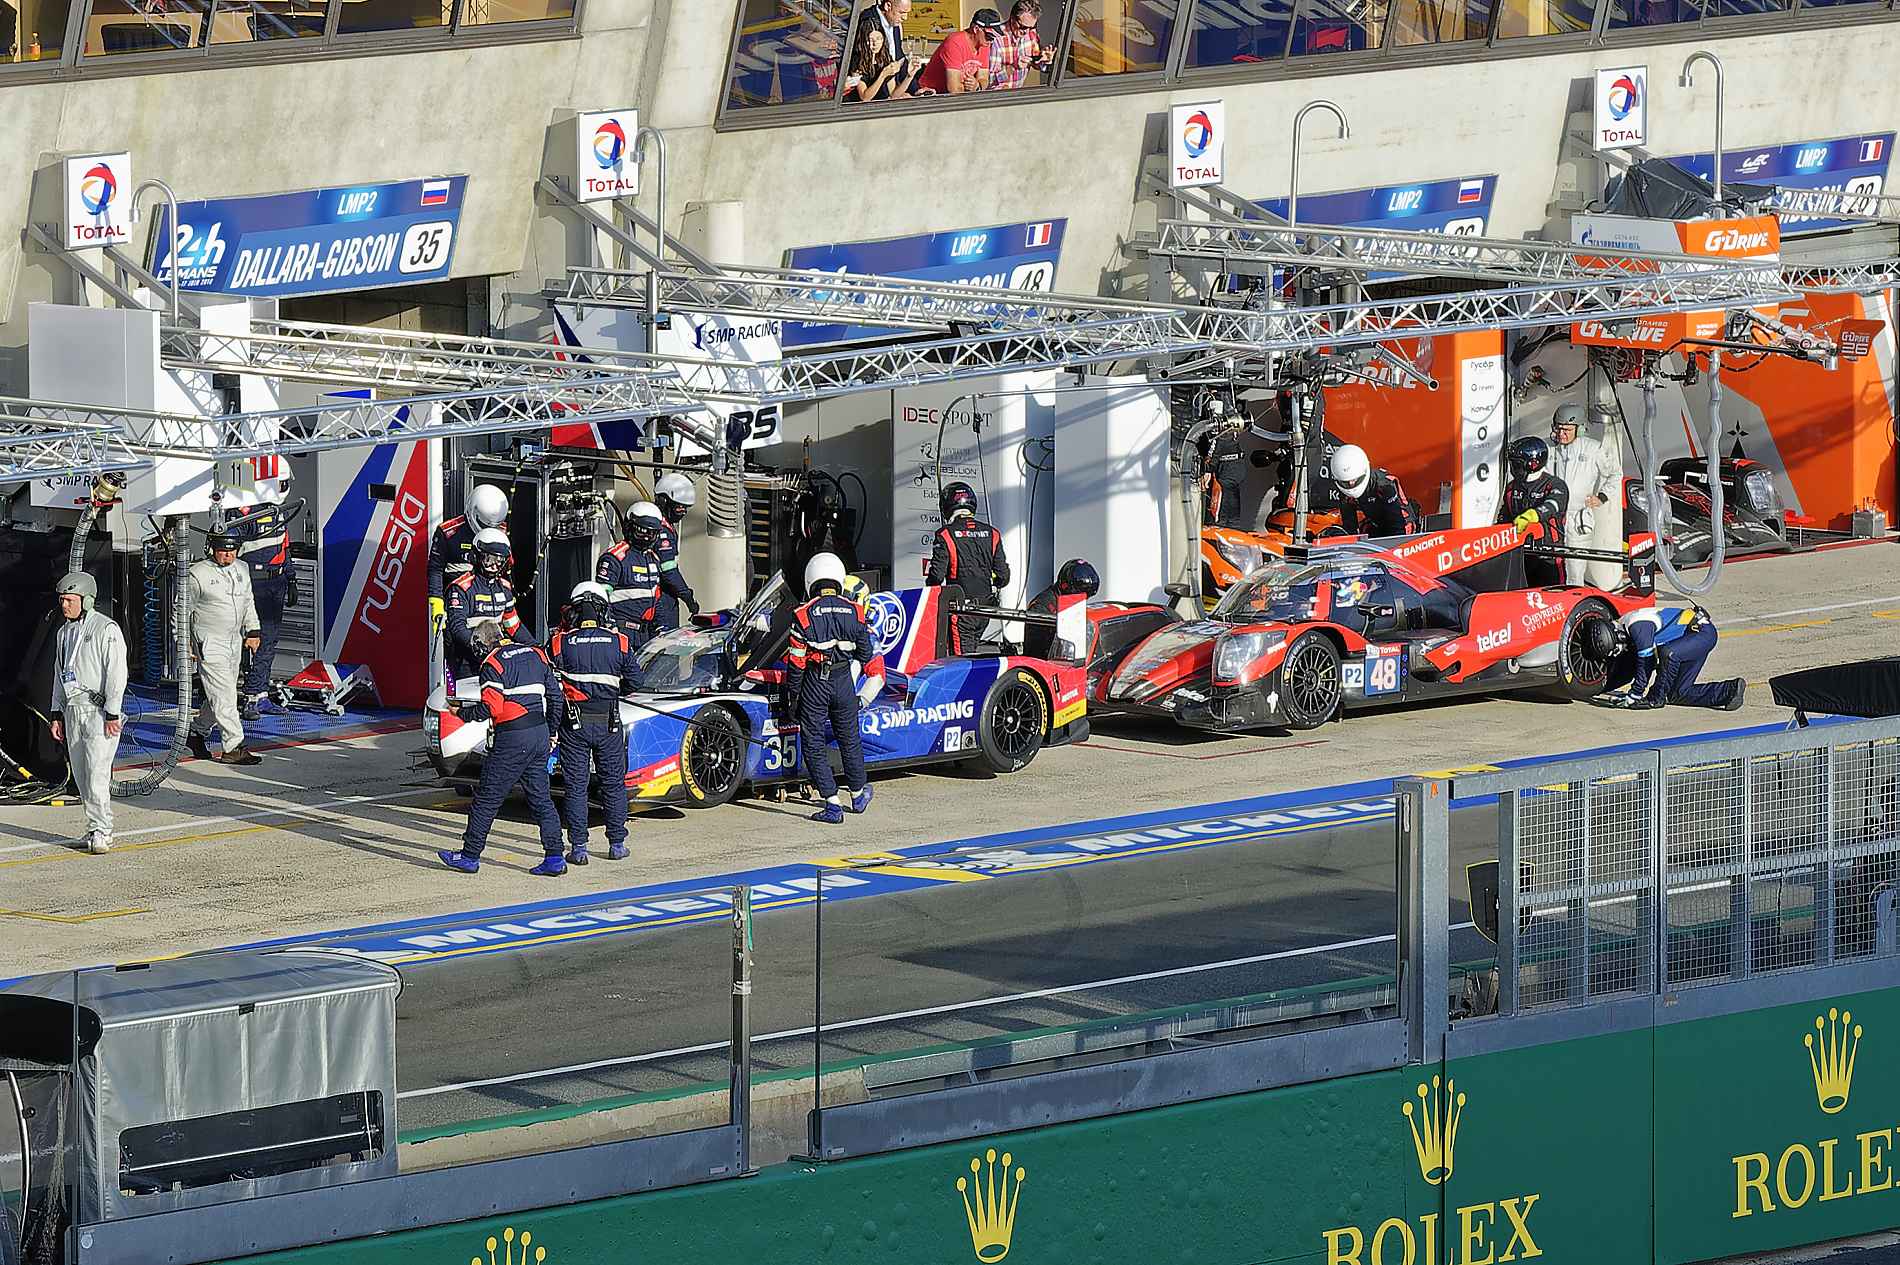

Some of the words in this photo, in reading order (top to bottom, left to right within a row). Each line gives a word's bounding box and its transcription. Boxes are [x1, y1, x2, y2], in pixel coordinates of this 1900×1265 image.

[1602, 129, 1643, 142] TOTAL
[1795, 147, 1828, 168] LMP2
[1177, 167, 1220, 180] TOTAL
[586, 178, 634, 192] TOTAL
[337, 191, 378, 215] LMP2
[1388, 190, 1423, 211] LMP2
[73, 225, 126, 240] TOTAL
[951, 234, 987, 256] LMP2
[230, 232, 400, 289] DALLARA-GIBSON
[410, 229, 443, 266] 35
[177, 266, 218, 280] MANS
[707, 329, 735, 344] SMP
[737, 321, 779, 340] RACING
[903, 406, 938, 424] IDEC
[83, 475, 128, 491] RAG
[1403, 535, 1446, 557] BANORTE
[1473, 526, 1519, 558] SPORT
[1631, 538, 1654, 556] MOTUL
[359, 491, 427, 634] russia
[1477, 622, 1512, 653] telcel
[1345, 668, 1361, 684] P2
[1370, 658, 1396, 691] 48
[880, 709, 915, 729] SMP
[917, 699, 974, 724] RACING
[946, 733, 959, 747] P2
[763, 735, 797, 771] 35
[1066, 797, 1397, 853] MICHEL
[400, 876, 871, 948] MICHELIN
[1732, 1127, 1900, 1219] ROLE
[1322, 1193, 1543, 1265] ROLEX
